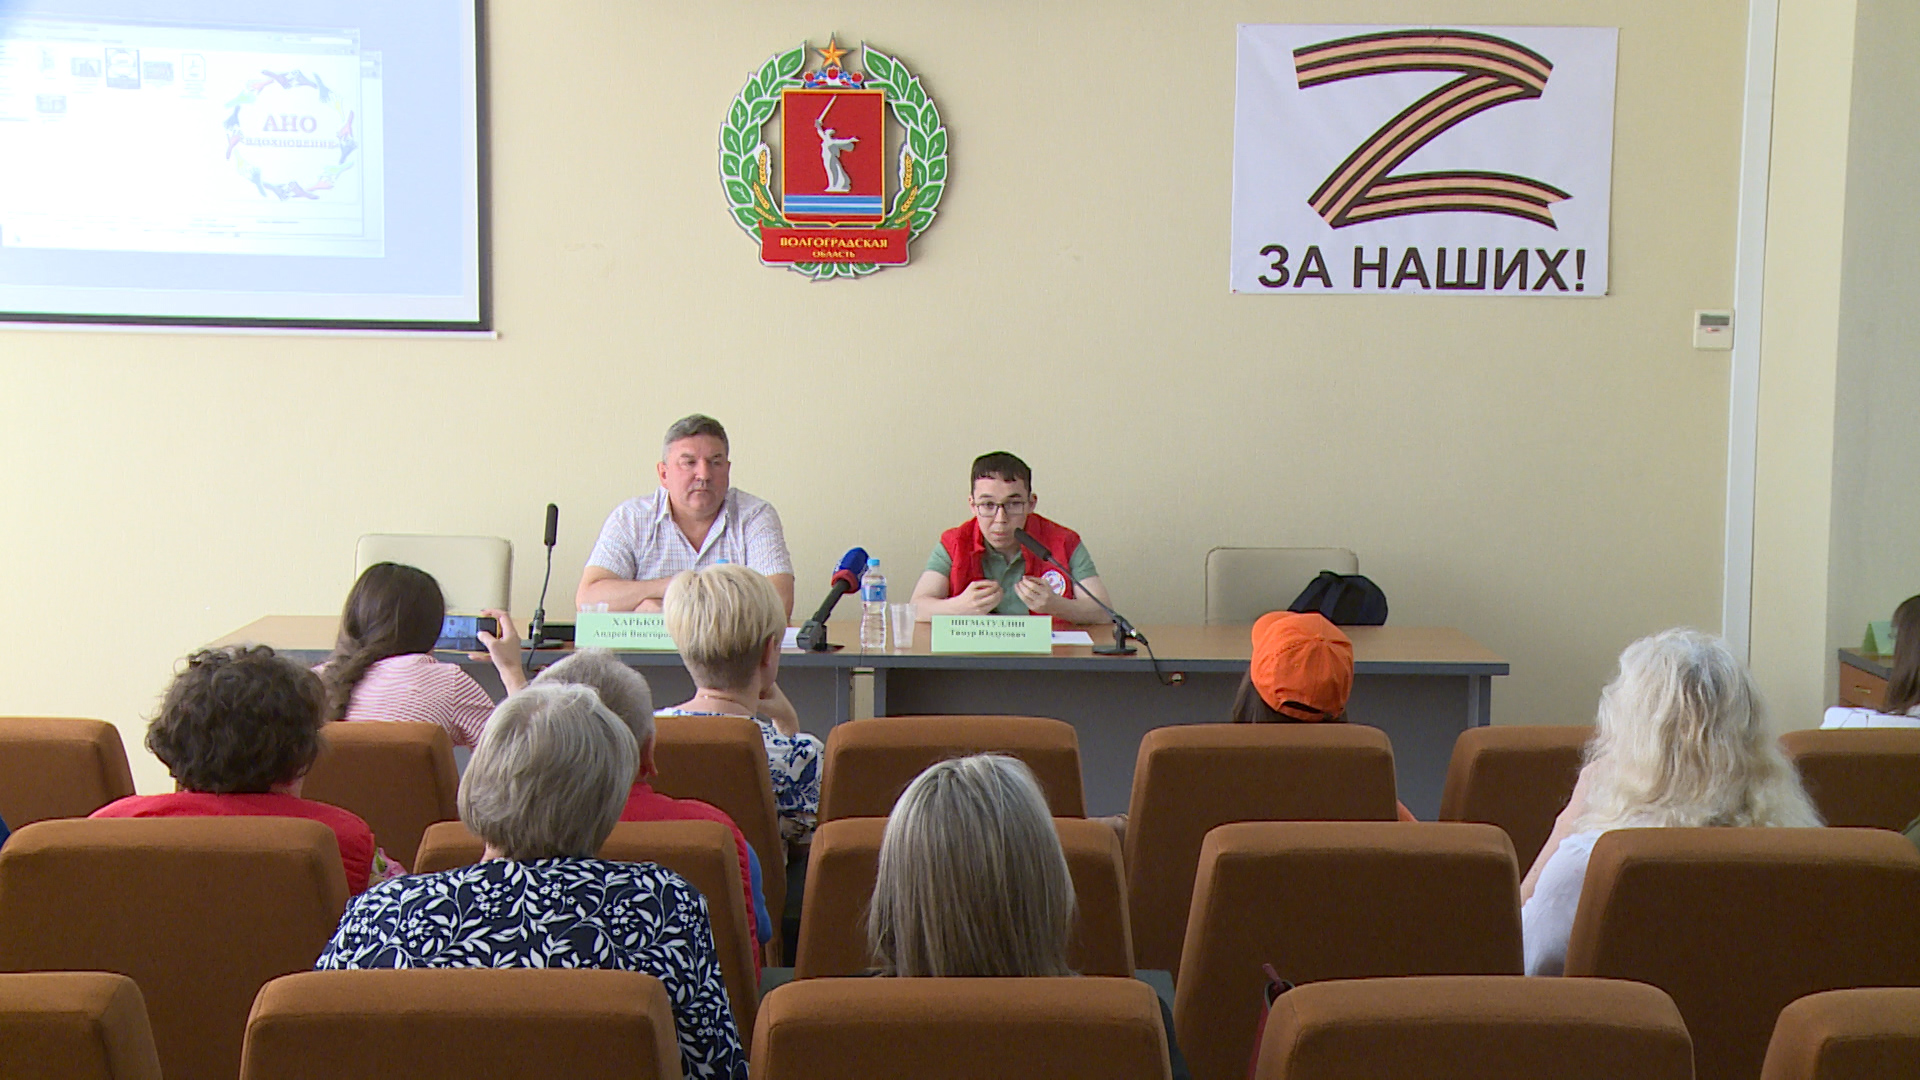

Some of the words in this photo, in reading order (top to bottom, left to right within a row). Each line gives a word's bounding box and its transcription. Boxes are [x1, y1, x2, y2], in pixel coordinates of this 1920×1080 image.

[263, 114, 317, 133] АНО
[1293, 29, 1574, 230] Z
[780, 236, 888, 249] ВОЛГОГРАДСКАЯ
[812, 250, 856, 259] ОБЛАСТЬ
[1258, 244, 1333, 289] ЗА
[1353, 245, 1586, 291] НАШИХ!
[594, 629, 627, 640] Андрей
